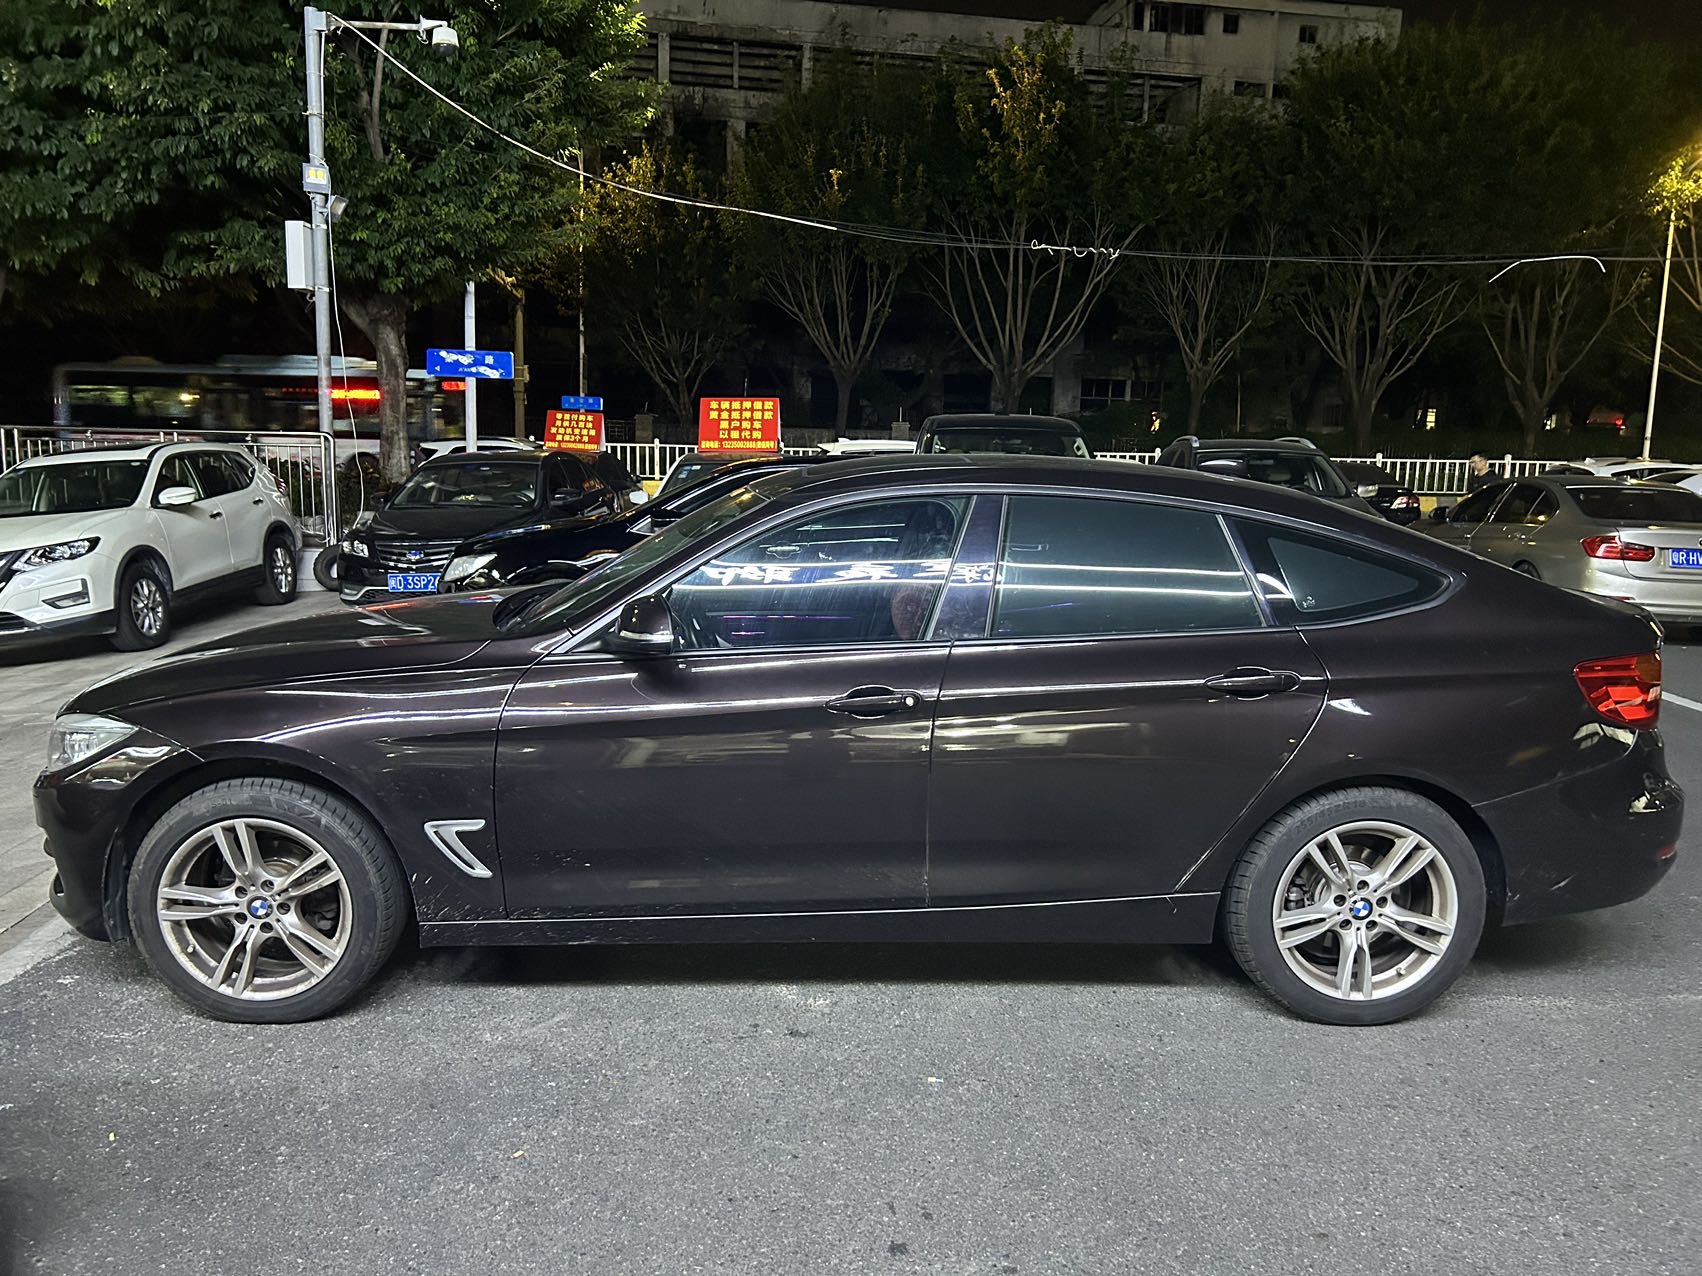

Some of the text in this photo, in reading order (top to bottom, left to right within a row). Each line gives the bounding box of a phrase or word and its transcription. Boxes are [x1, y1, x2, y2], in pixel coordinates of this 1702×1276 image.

[709, 401, 774, 410] 车辆抵押借款
[709, 410, 774, 420] 黄金抵押借款
[720, 420, 762, 430] 黑户购车
[719, 430, 762, 439] 以租代购
